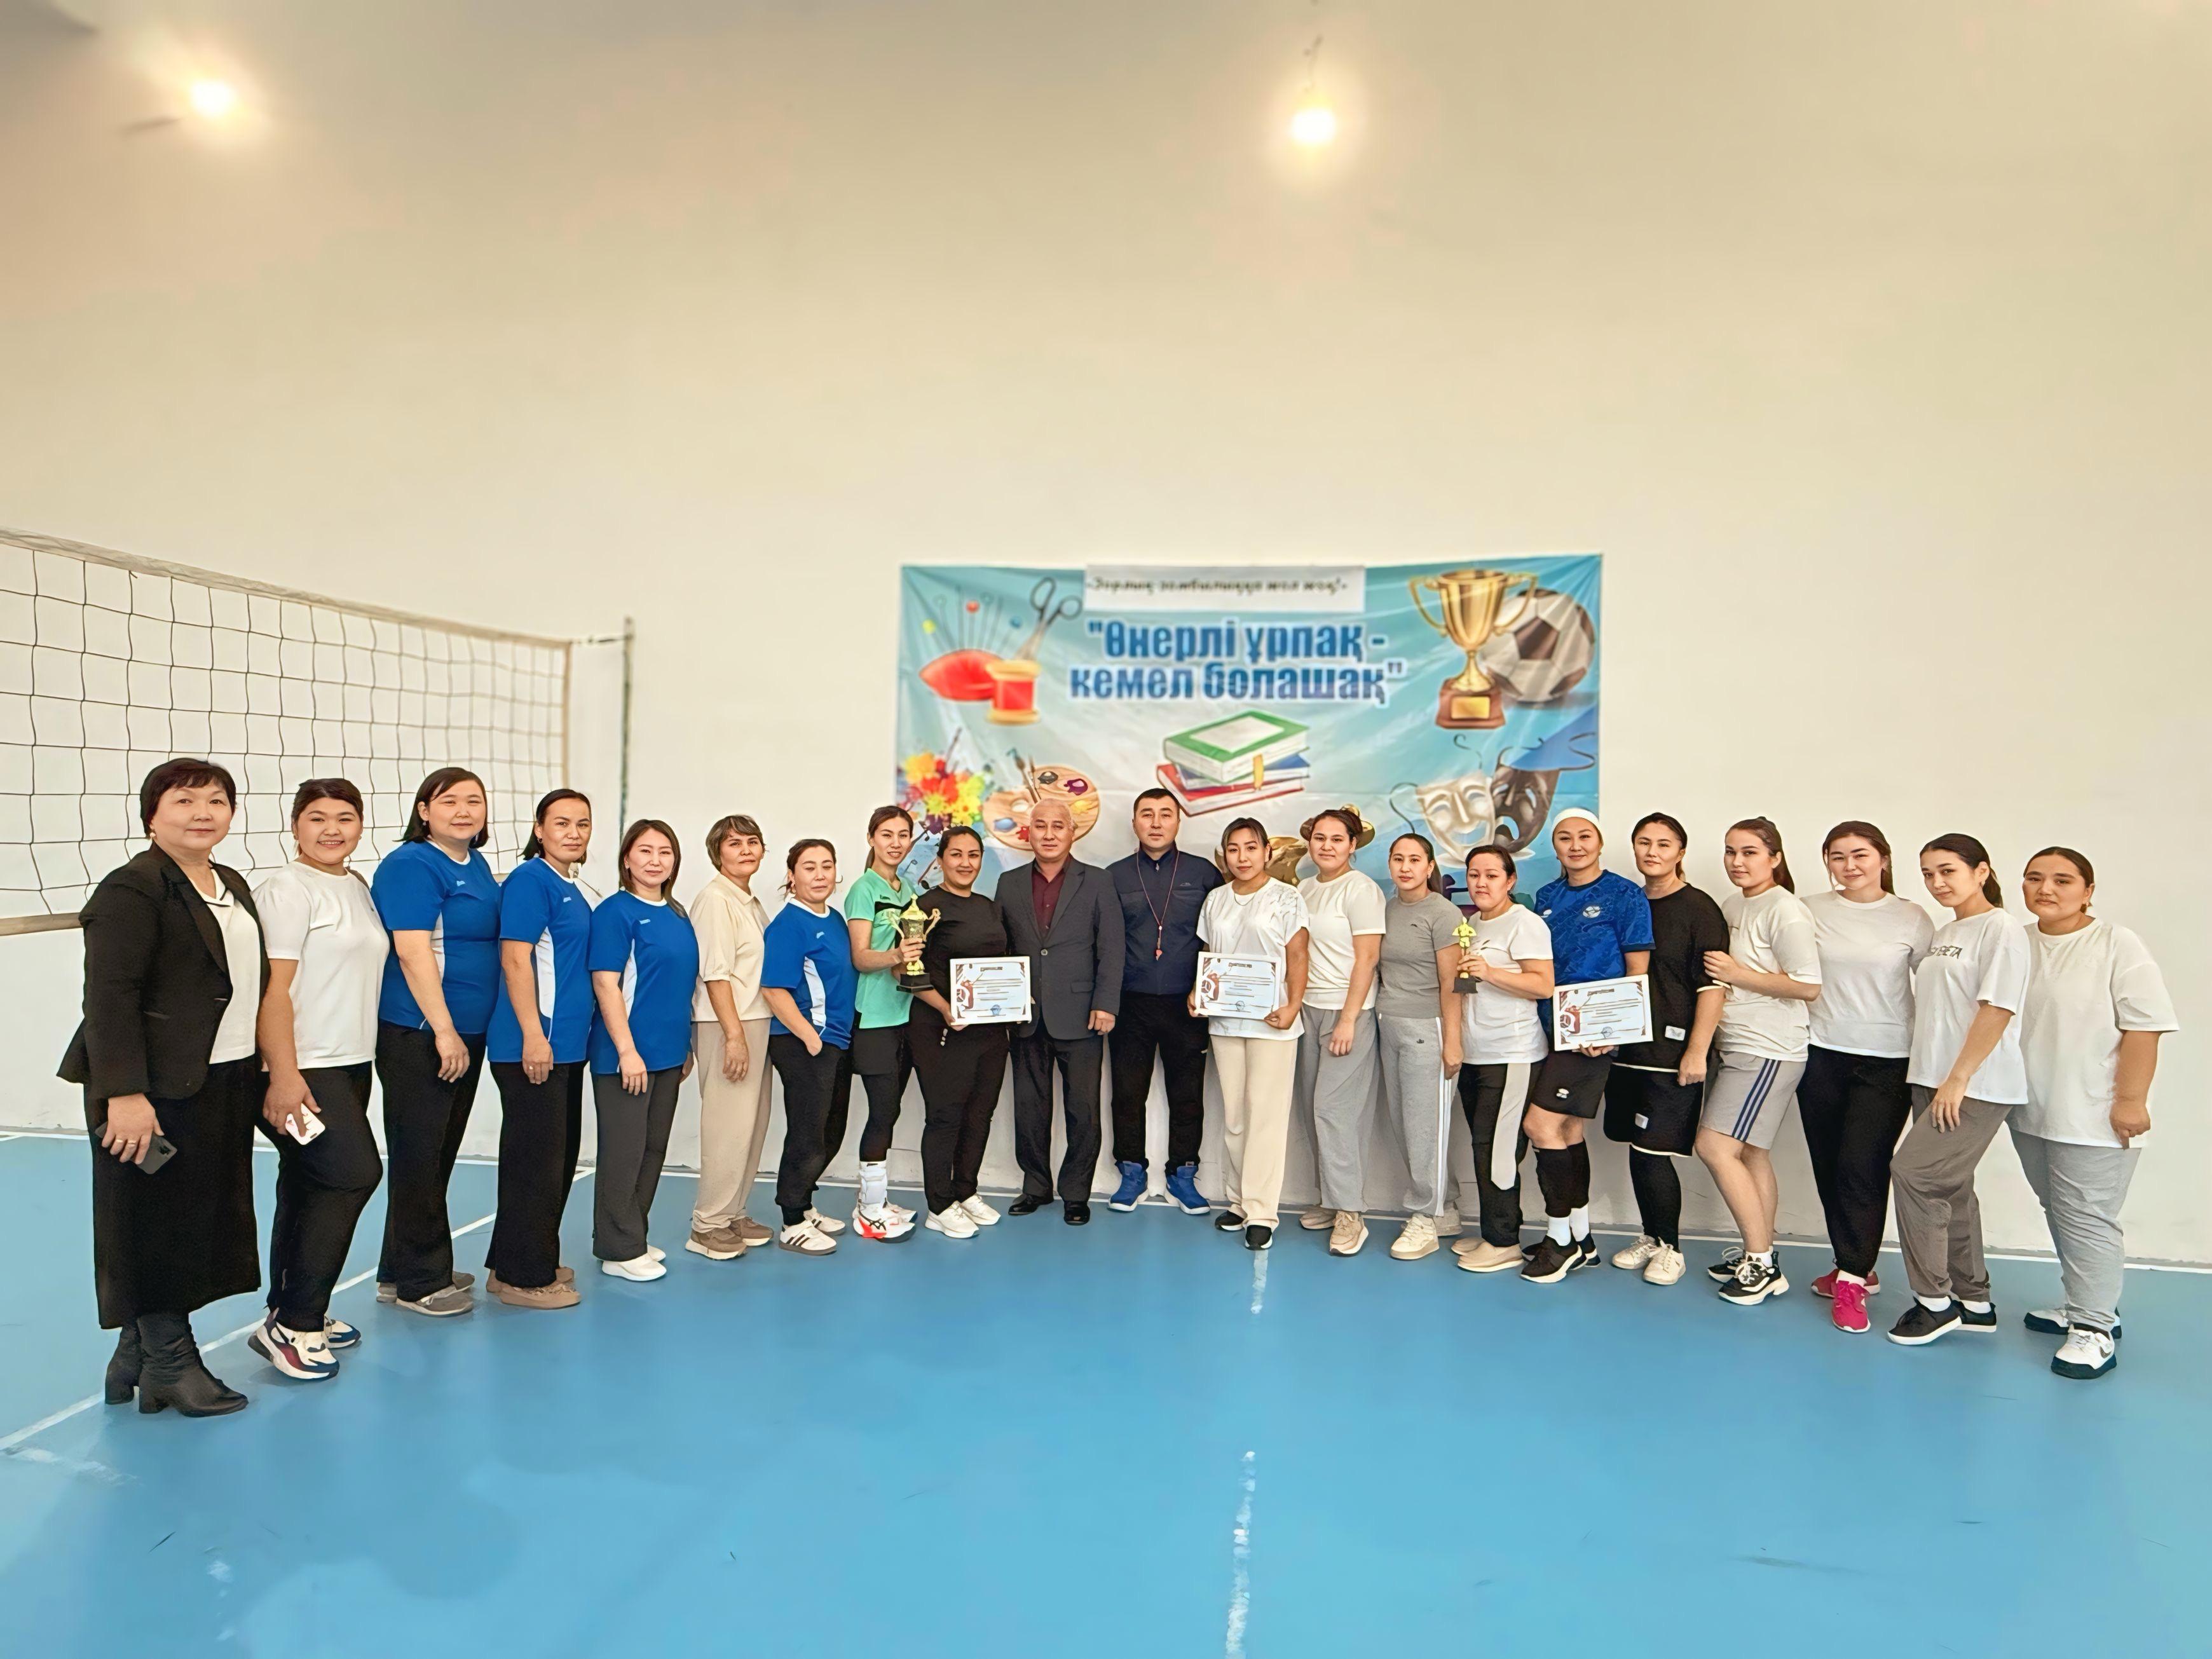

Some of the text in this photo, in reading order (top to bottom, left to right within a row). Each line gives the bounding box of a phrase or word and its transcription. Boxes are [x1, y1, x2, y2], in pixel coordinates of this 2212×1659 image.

[1088, 620, 1236, 663] "Өнерлі
[1246, 624, 1364, 664] ұрпақ
[1070, 661, 1403, 705] кемел болашақ"
